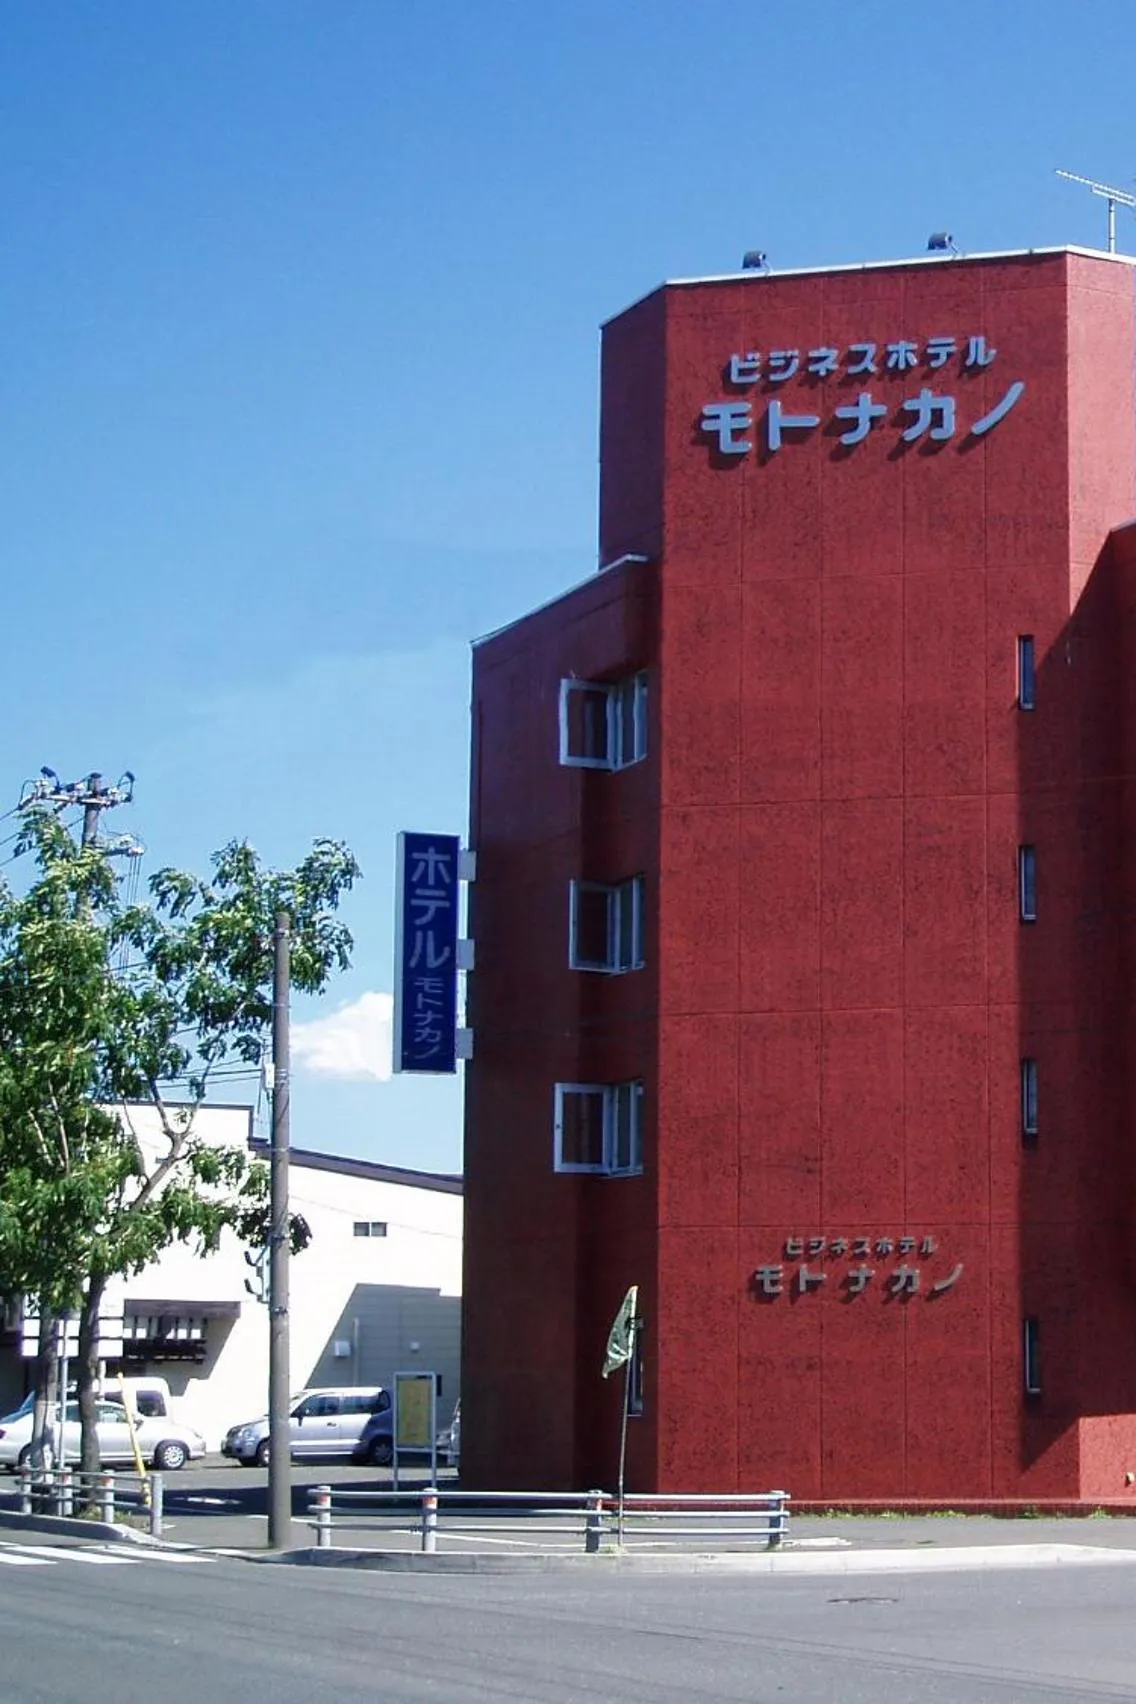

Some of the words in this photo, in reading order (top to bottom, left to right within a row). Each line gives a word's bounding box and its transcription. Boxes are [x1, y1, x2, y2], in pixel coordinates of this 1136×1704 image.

[730, 336, 997, 384] ビジネスホテル
[701, 381, 1026, 454] モトナカノ
[409, 846, 451, 969] ホテル
[414, 976, 445, 1060] モトナカノ
[786, 1236, 939, 1255] ビジネスホテル
[755, 1263, 964, 1293] モトナカノ
